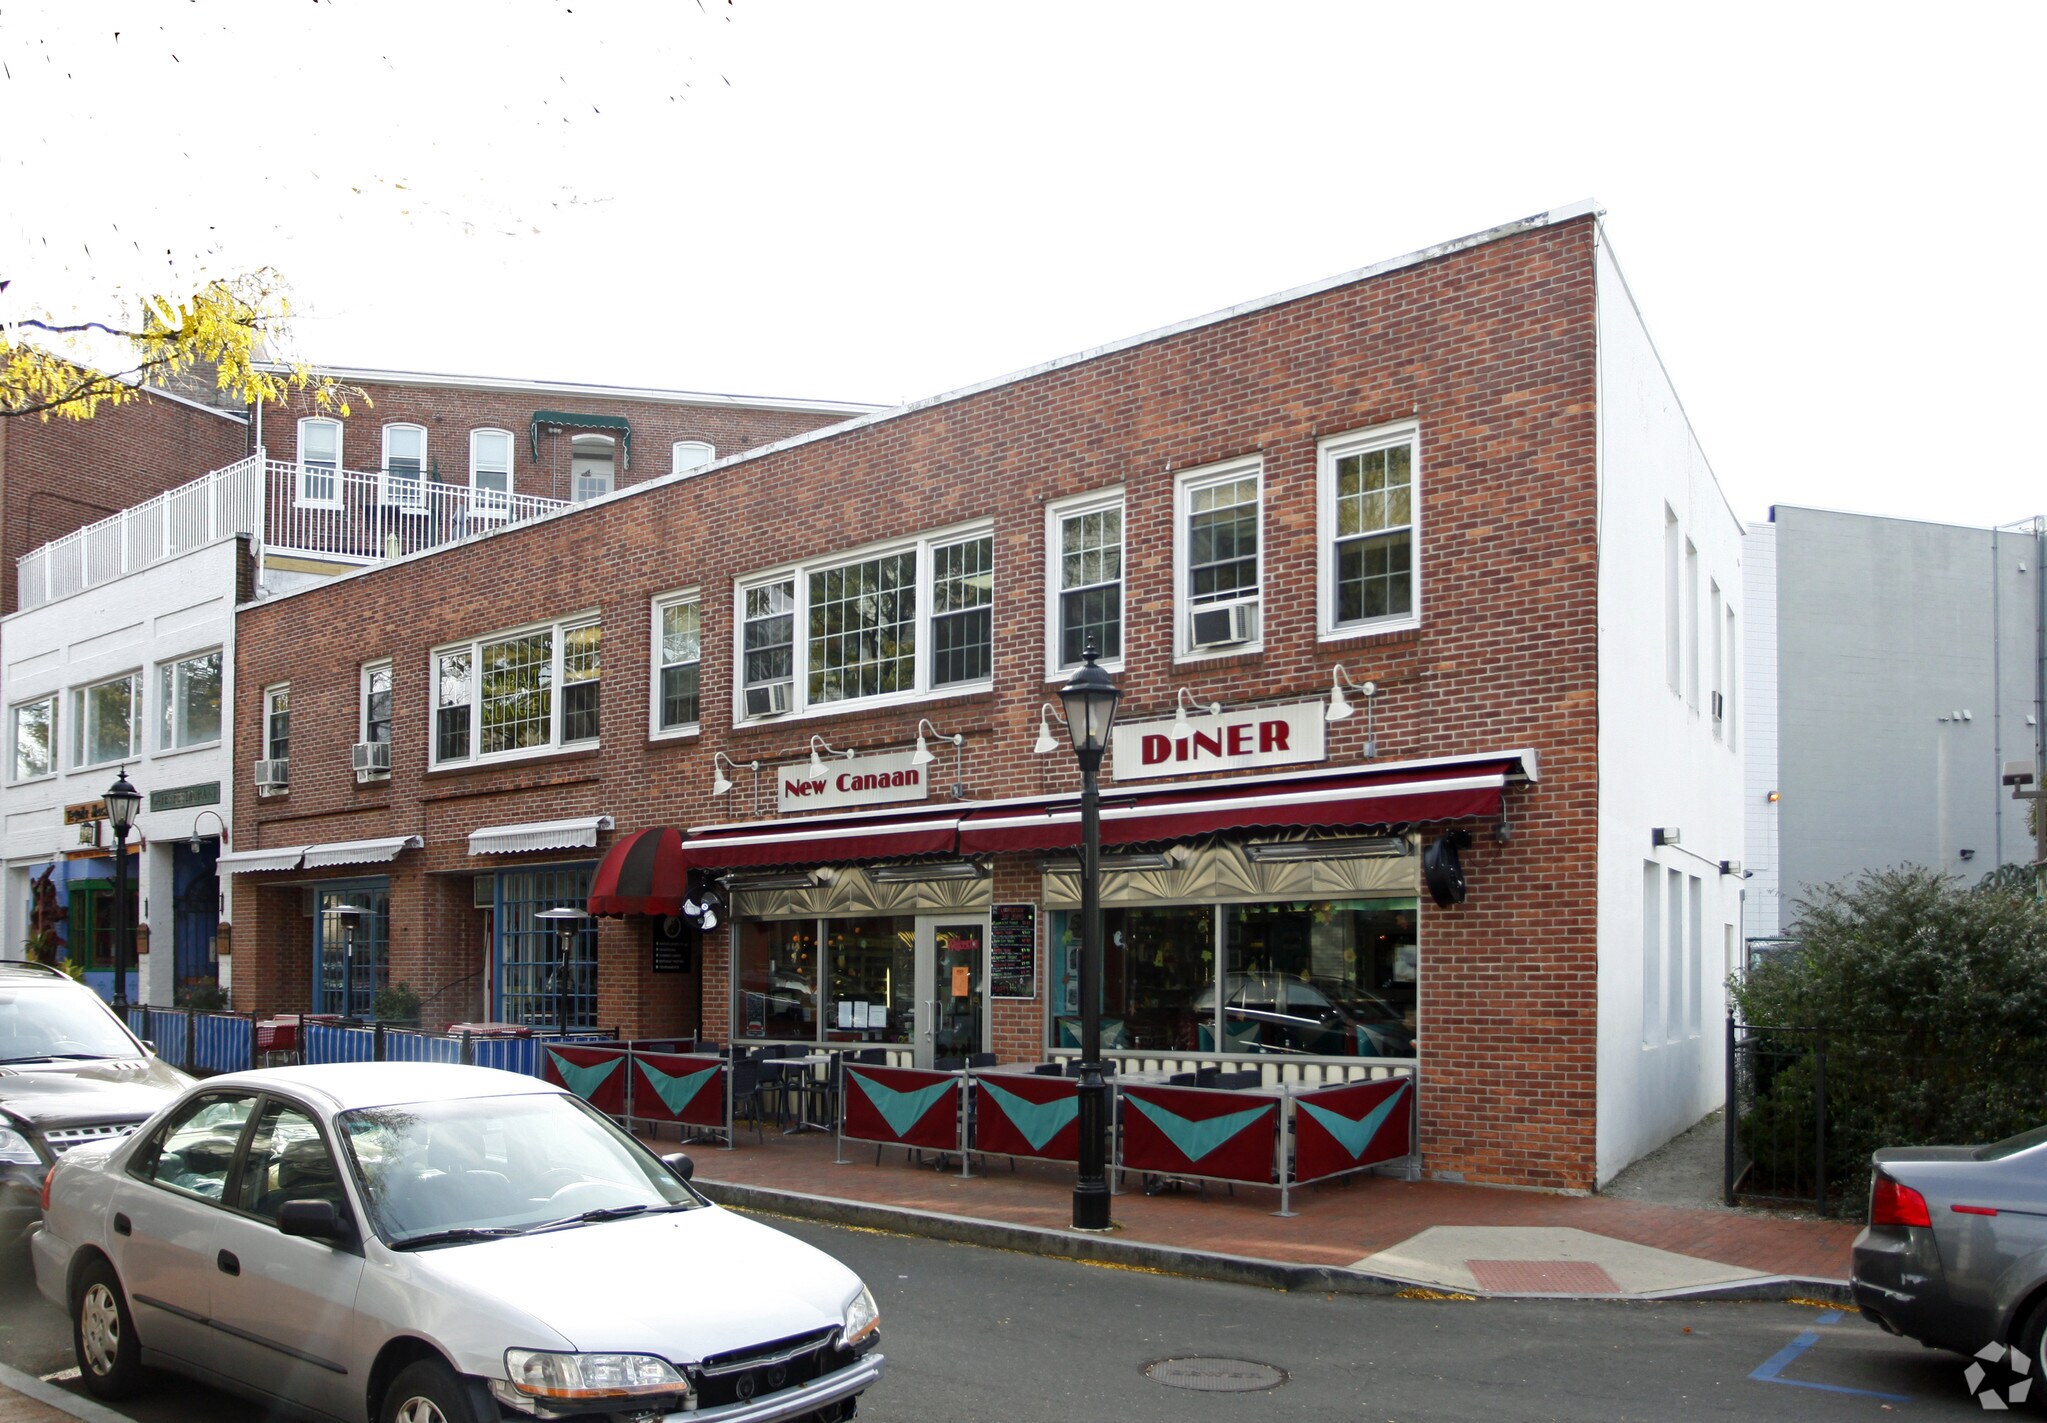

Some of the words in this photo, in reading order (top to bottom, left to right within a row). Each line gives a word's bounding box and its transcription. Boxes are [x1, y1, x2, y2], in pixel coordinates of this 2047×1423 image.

[1142, 720, 1290, 765] DINER
[785, 779, 827, 798] New
[836, 769, 919, 792] Canaan
